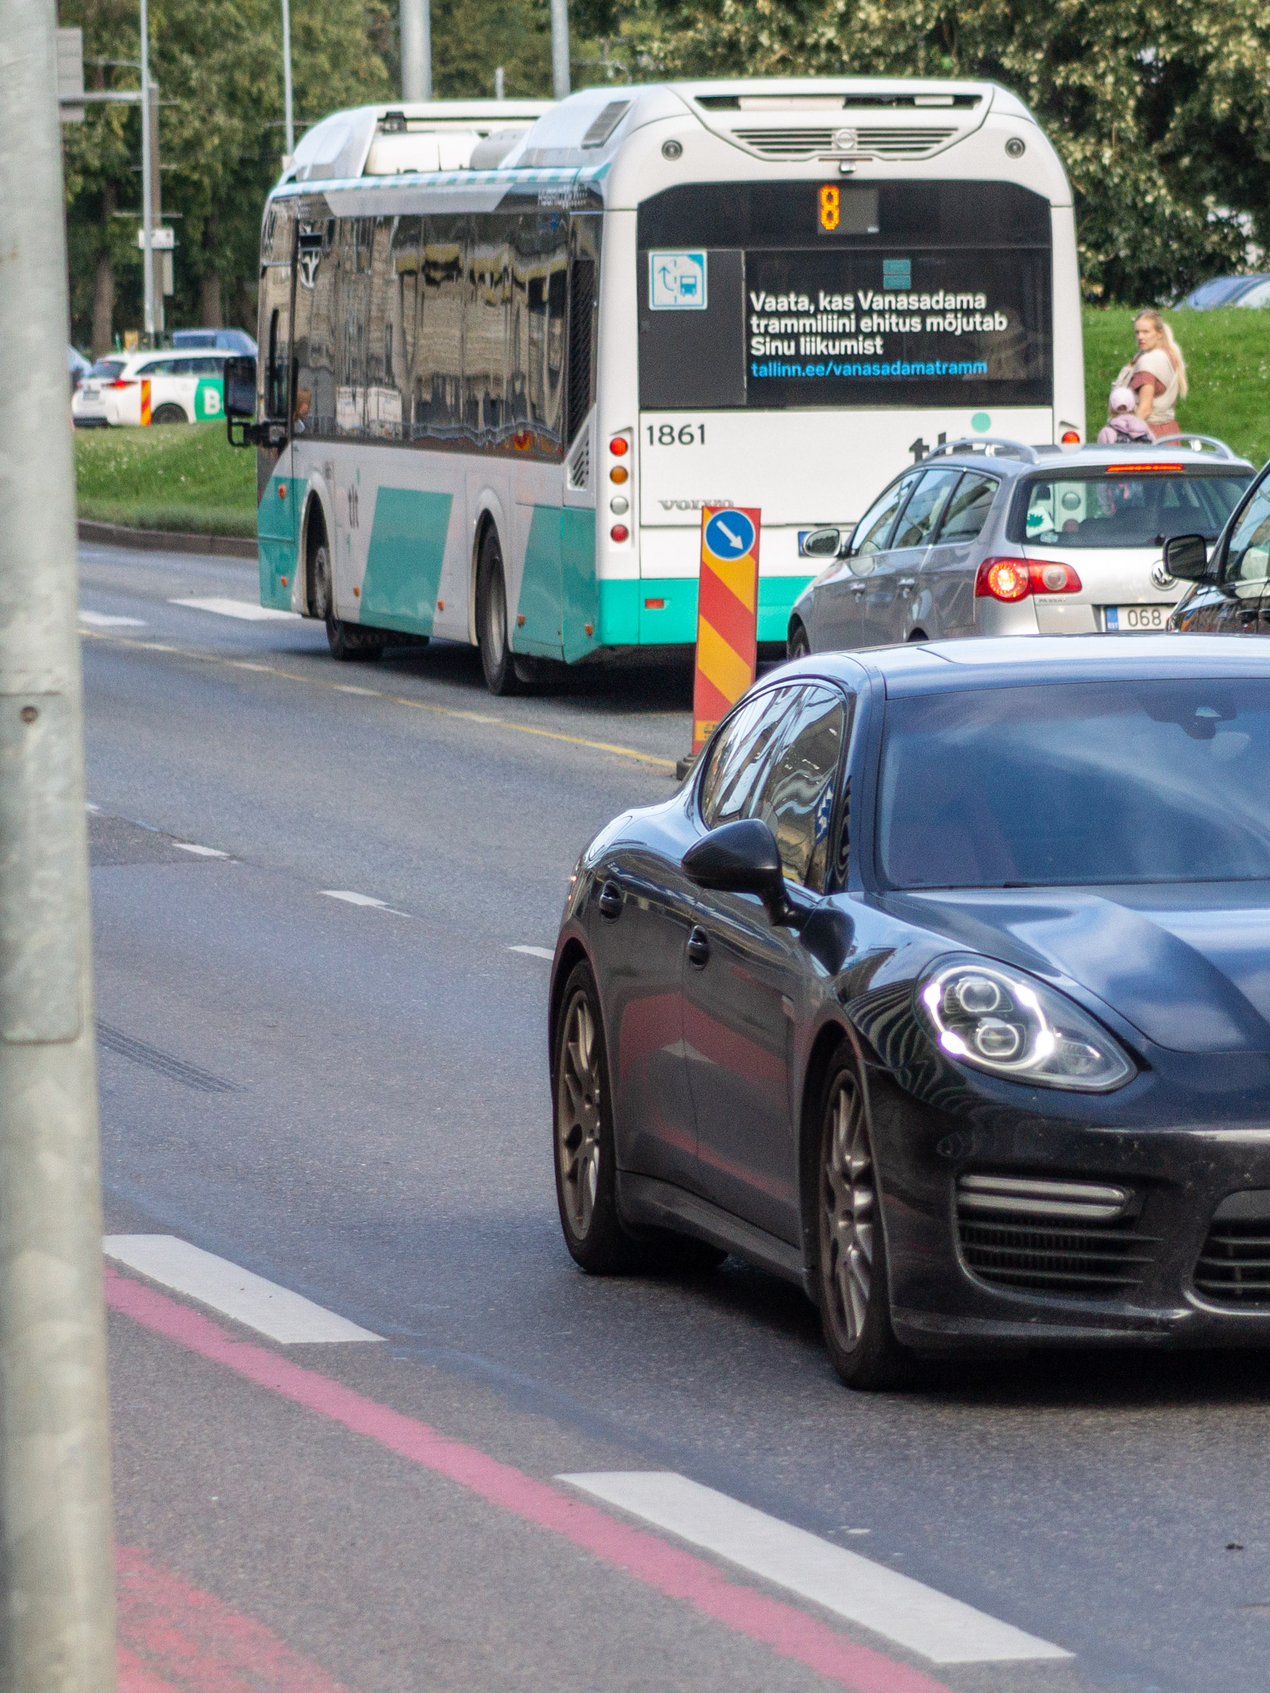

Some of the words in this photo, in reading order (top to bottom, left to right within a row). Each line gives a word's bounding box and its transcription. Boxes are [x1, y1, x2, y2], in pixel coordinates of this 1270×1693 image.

[821, 185, 839, 230] 8
[750, 290, 815, 314] Vaata,
[819, 290, 854, 312] kas
[858, 289, 987, 311] Vanasadama
[750, 313, 856, 334] trammiliini
[860, 313, 922, 332] ehitus
[925, 310, 1008, 335] mõjutab
[750, 335, 795, 356] Sinu
[800, 334, 884, 356] liikumist
[751, 359, 988, 377] tallinn.ee/vanasadamatramm
[646, 424, 706, 446] 1861
[1127, 608, 1162, 627] 068
